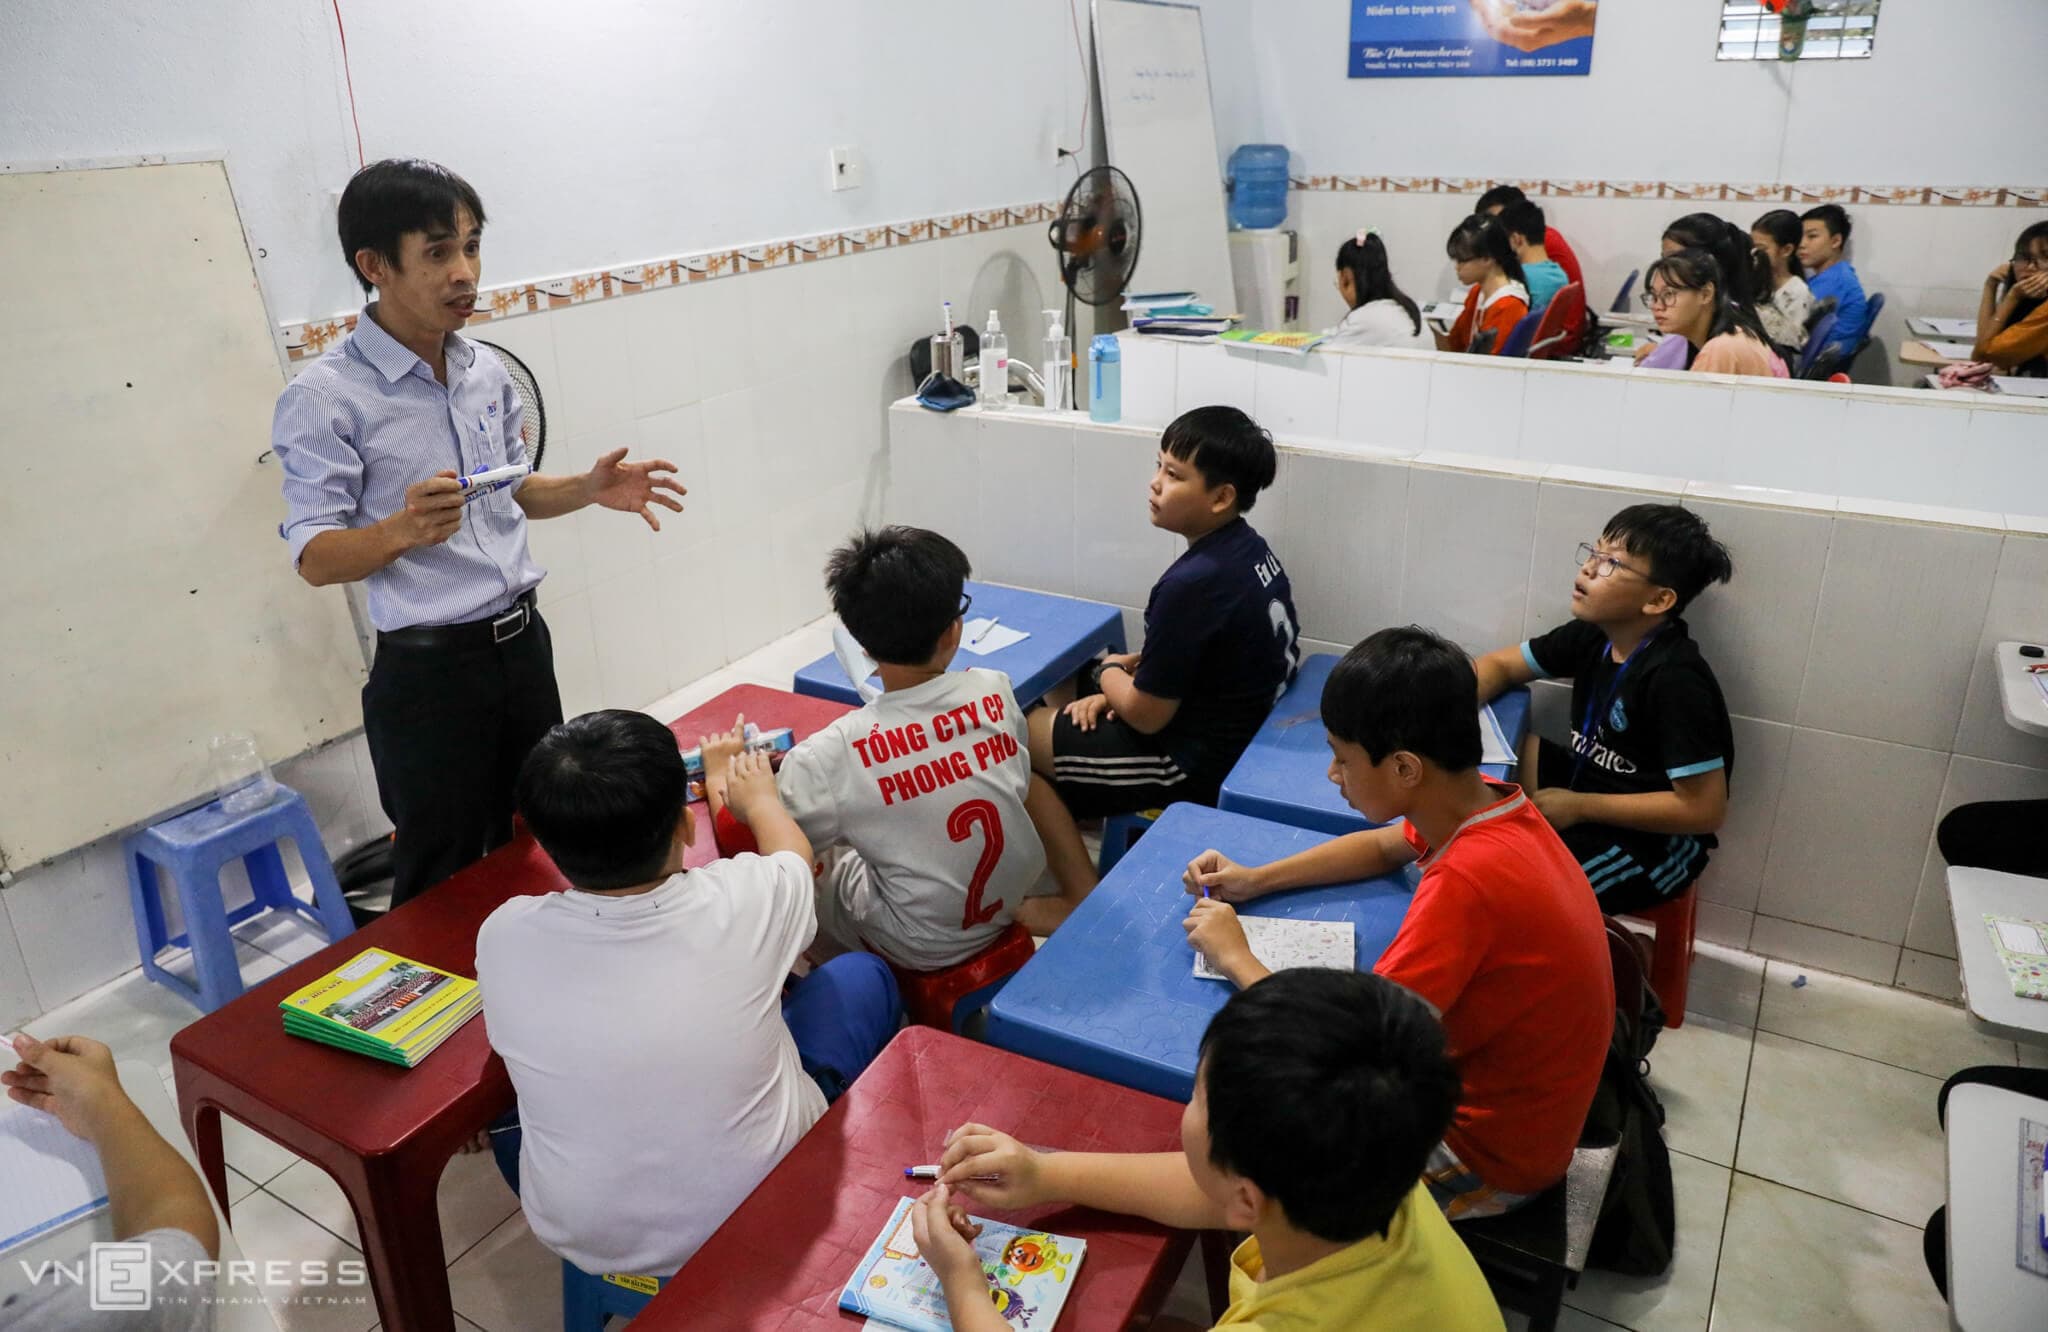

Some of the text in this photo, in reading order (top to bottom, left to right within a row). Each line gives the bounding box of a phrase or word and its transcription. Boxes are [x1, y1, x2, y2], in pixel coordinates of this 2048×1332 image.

[852, 694, 1005, 768] TỔNG CTY CP
[877, 752, 973, 806] PHONG
[946, 799, 1003, 930] 2
